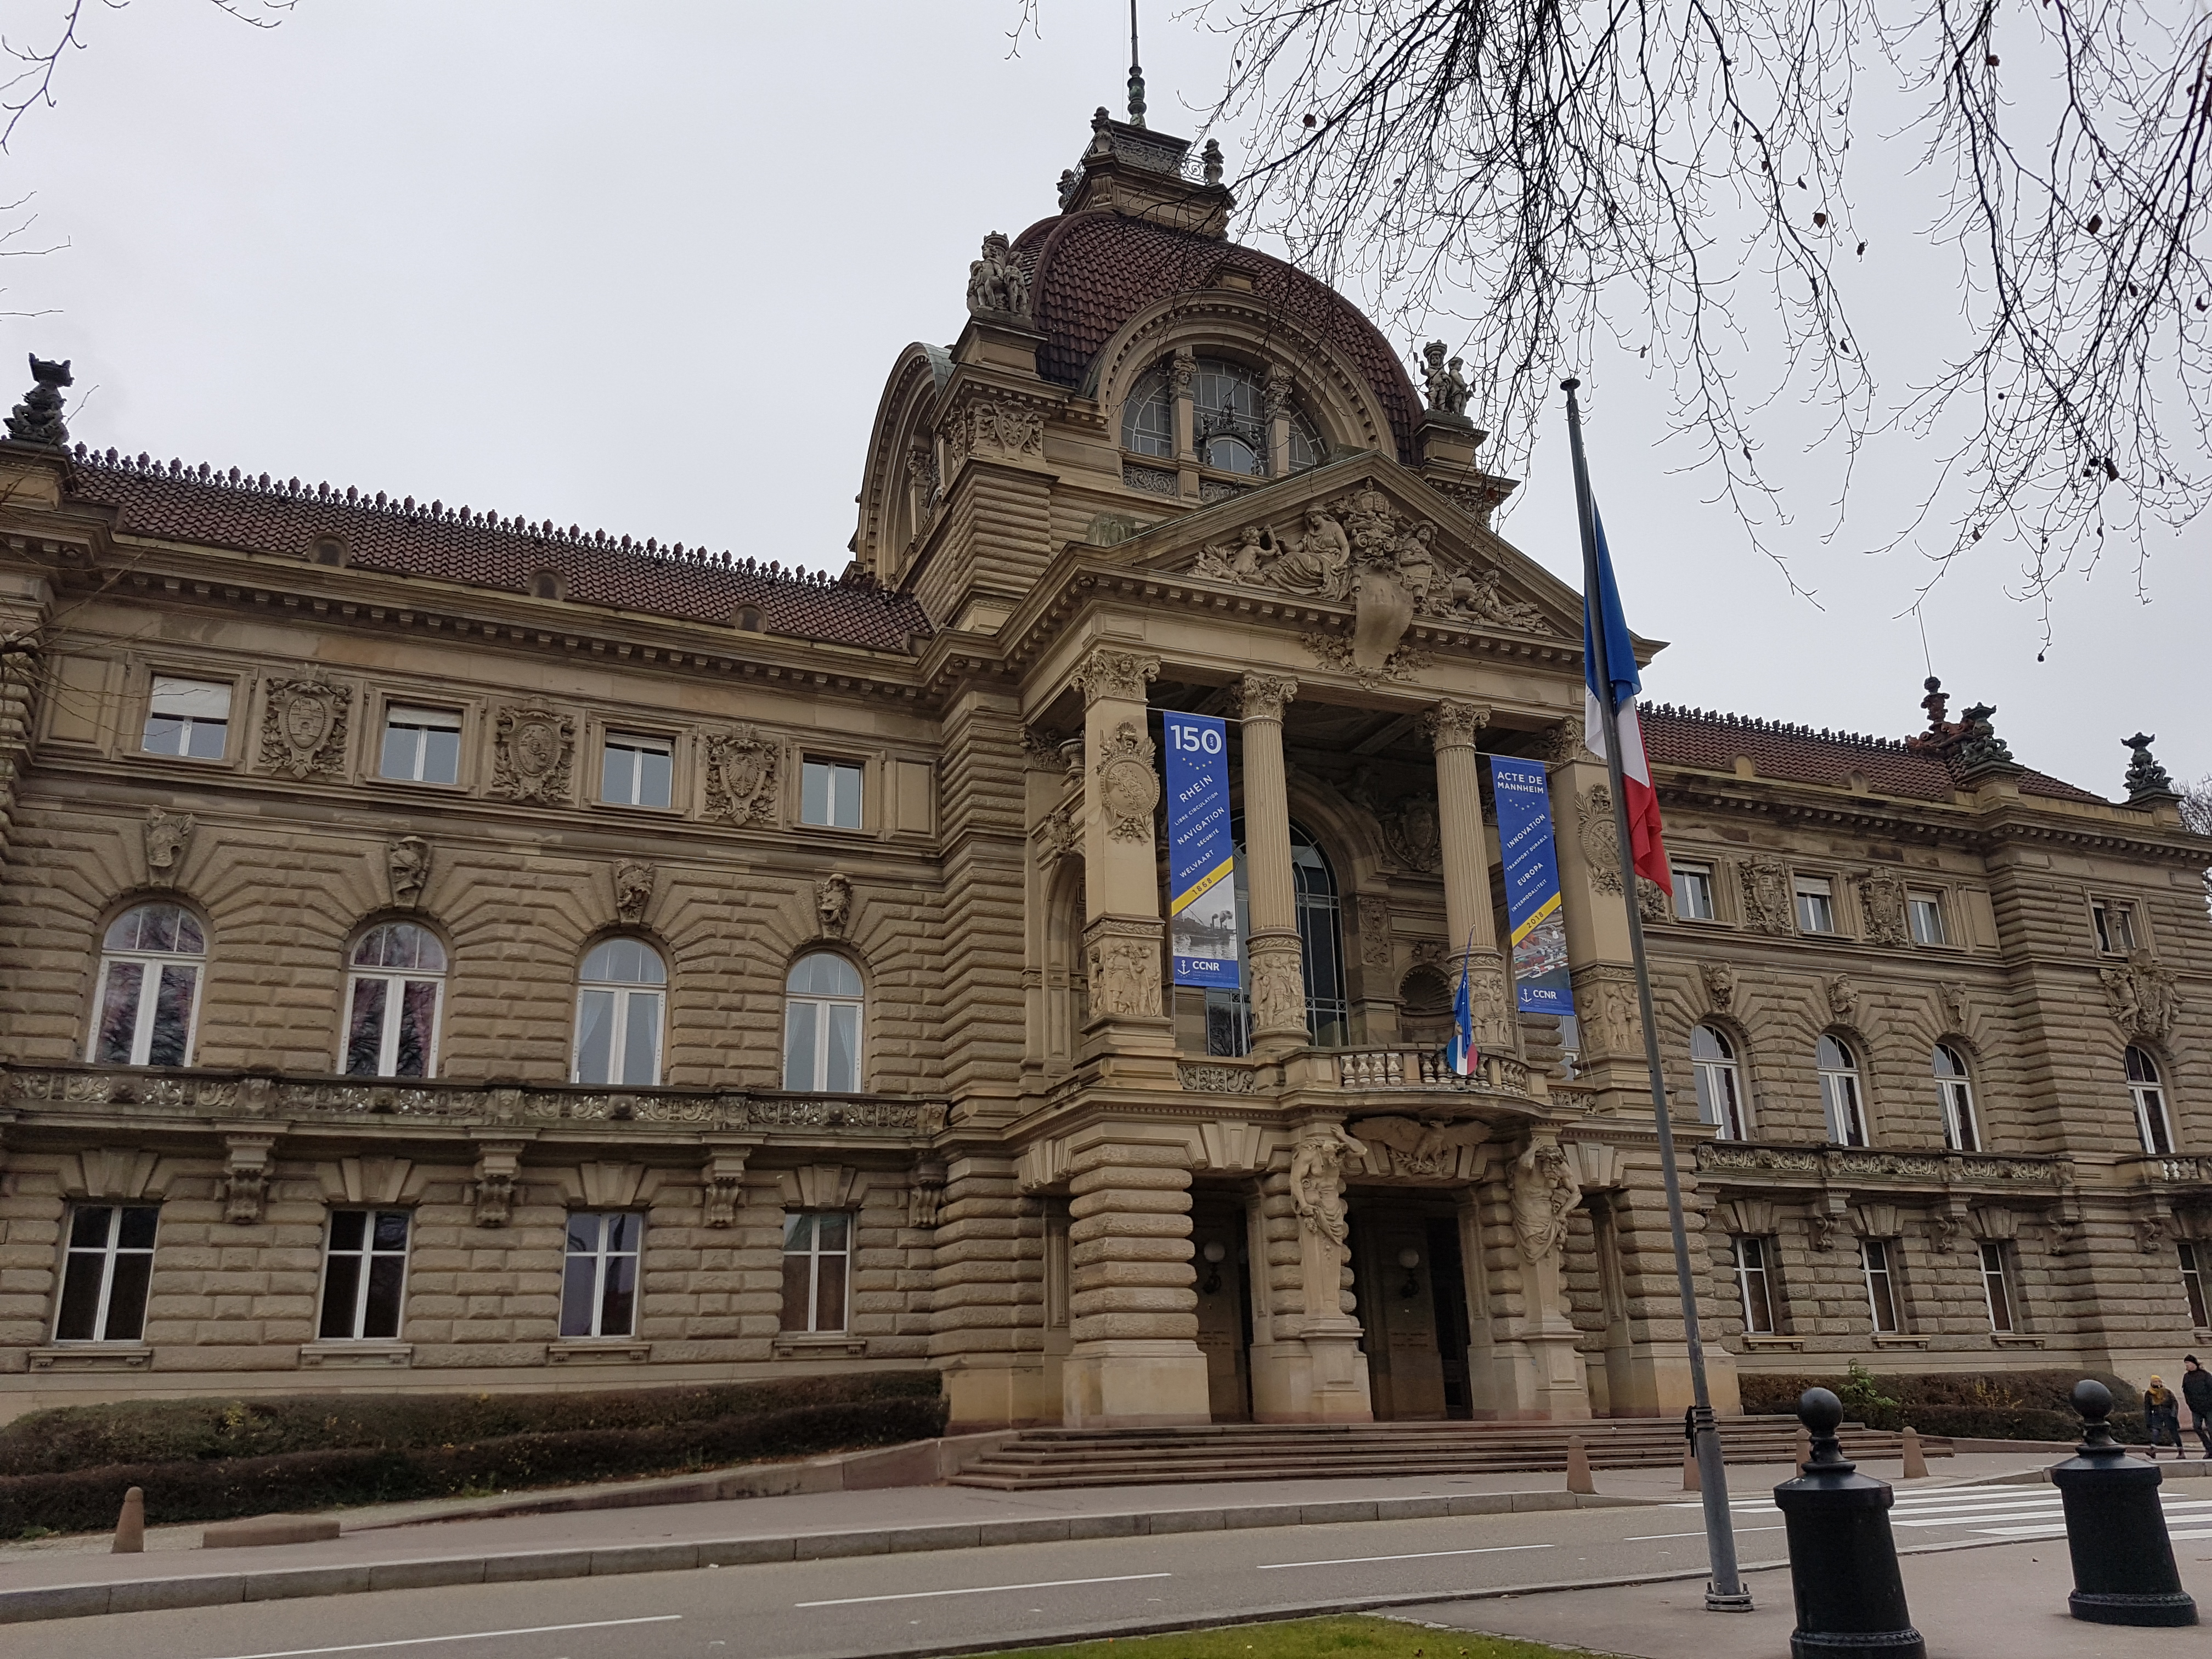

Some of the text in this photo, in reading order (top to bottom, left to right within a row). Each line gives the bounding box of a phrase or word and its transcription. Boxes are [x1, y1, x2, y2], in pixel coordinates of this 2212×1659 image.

[1170, 725, 1222, 754] 150
[1179, 775, 1213, 803] RHEIN
[1497, 771, 1543, 785] ACTE DE
[1497, 781, 1544, 794] MANNHEIM
[1174, 792, 1218, 826] LIBRE CIRCULATION
[1177, 806, 1224, 845] NAVIGATION
[1506, 813, 1546, 849] INNOVATION
[1180, 849, 1214, 878] WELVAART
[1506, 834, 1548, 871] TRANSPORT DURABLE
[1192, 878, 1212, 895] 1868
[1517, 862, 1543, 886] EUROPA
[1511, 879, 1547, 912] INTERMODALITEIT
[1526, 911, 1544, 929] 2018
[1192, 961, 1220, 971] CCNR
[1533, 989, 1557, 1000] CCNR
